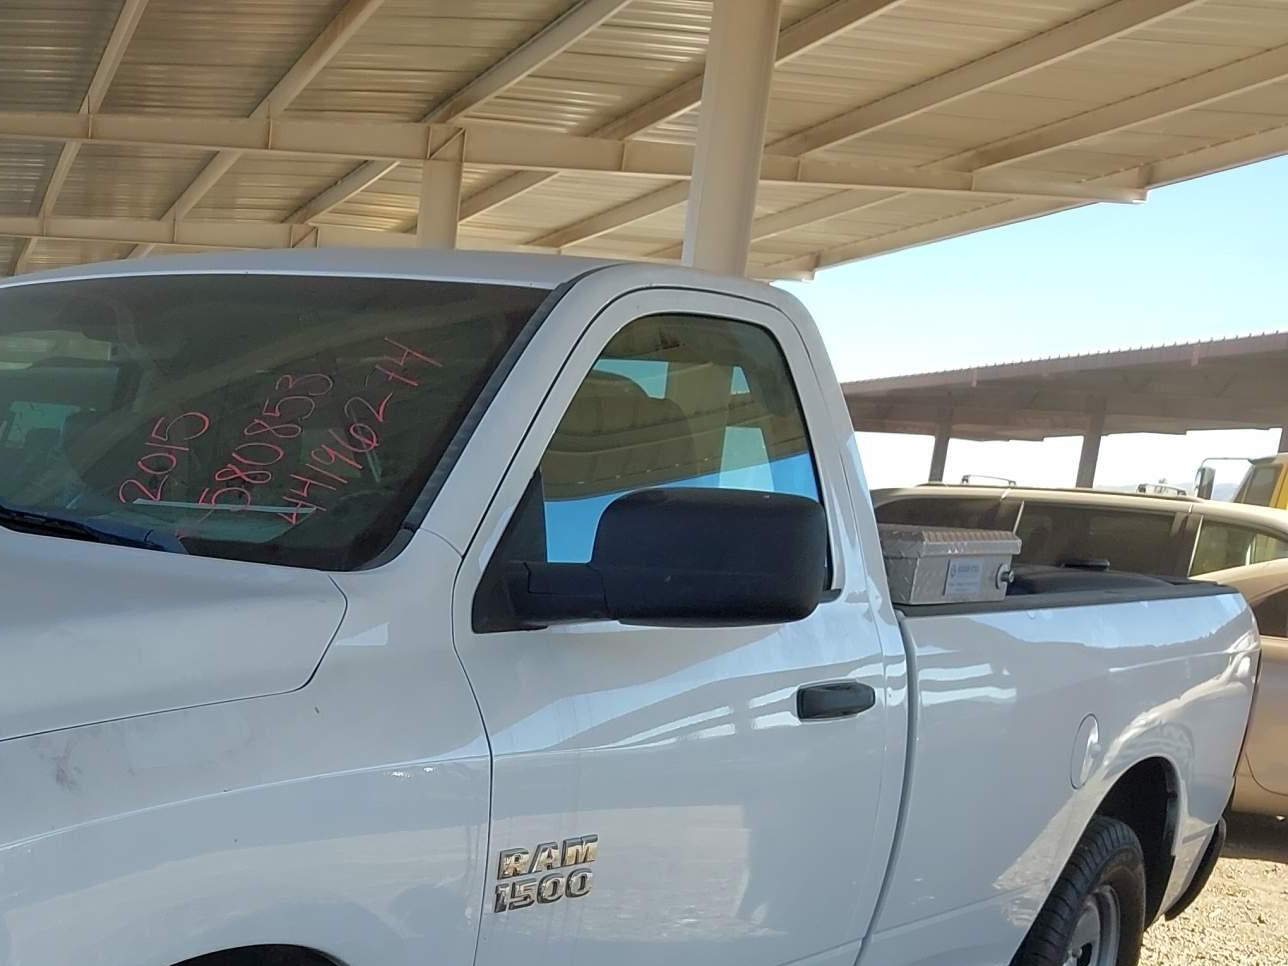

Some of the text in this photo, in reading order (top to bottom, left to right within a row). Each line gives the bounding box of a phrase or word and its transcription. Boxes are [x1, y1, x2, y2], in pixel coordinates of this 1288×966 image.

[119, 411, 210, 503] 2015
[198, 373, 334, 511] 580853
[494, 867, 593, 913] 1500
[497, 833, 599, 880] RAM
